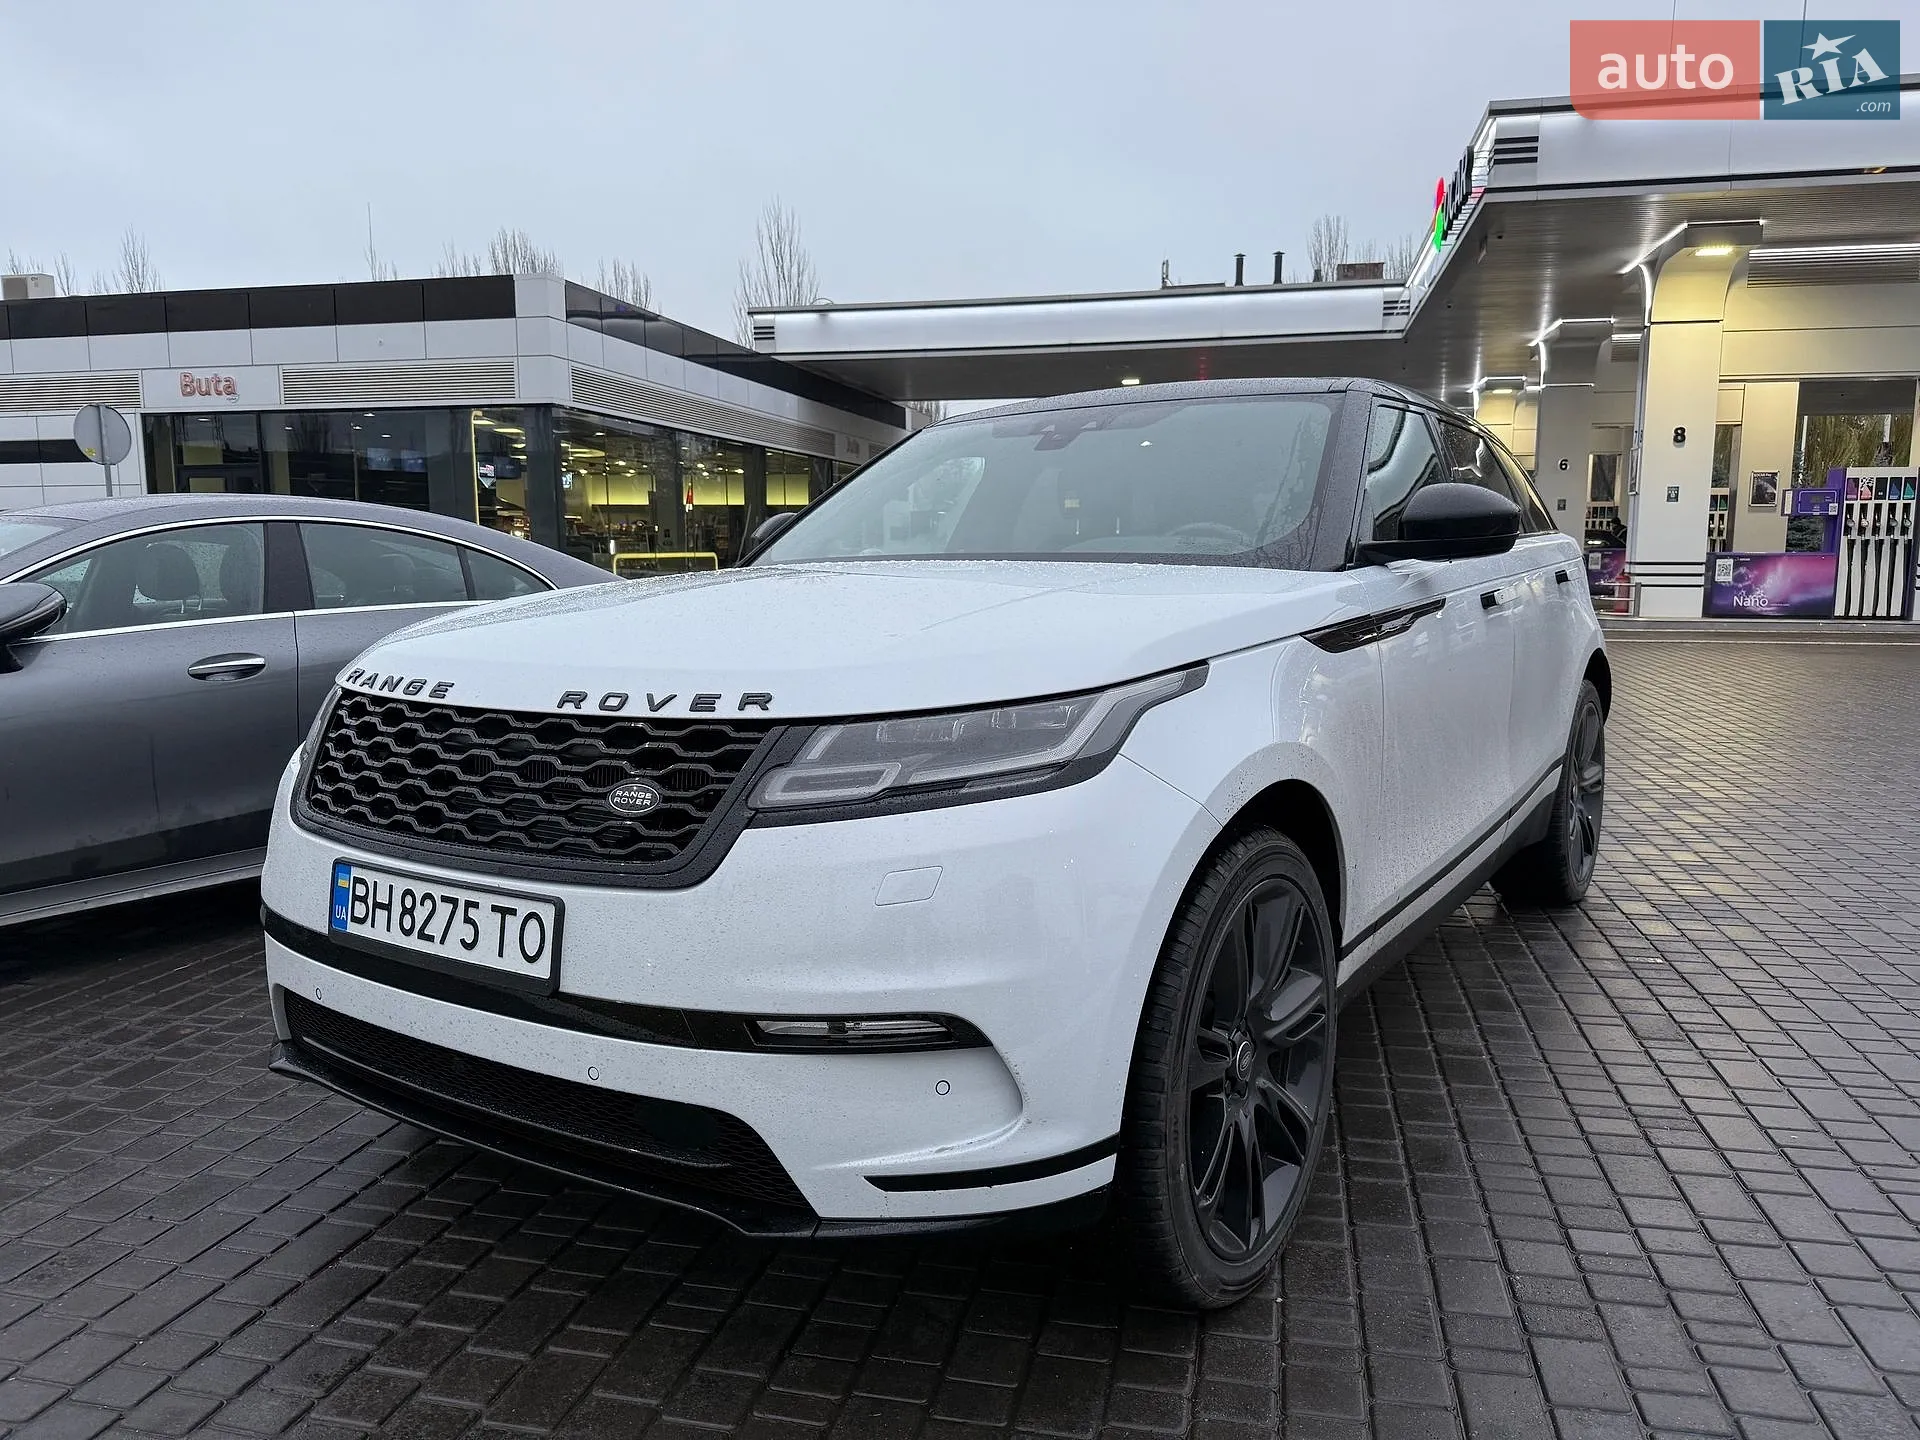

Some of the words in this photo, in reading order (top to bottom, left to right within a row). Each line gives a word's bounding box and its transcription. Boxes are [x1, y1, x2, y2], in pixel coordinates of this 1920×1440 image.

[180, 371, 237, 397] Buta
[1673, 426, 1686, 443] 8
[1559, 458, 1569, 471] 6
[1733, 595, 1768, 607] Nano
[345, 667, 455, 699] RANGE
[557, 690, 774, 713] ROVER
[613, 797, 651, 806] ROVER
[615, 790, 652, 798] RANGE
[335, 904, 347, 920] UA
[350, 875, 394, 932] BH
[399, 888, 480, 950] 8275
[490, 904, 546, 964] TO
